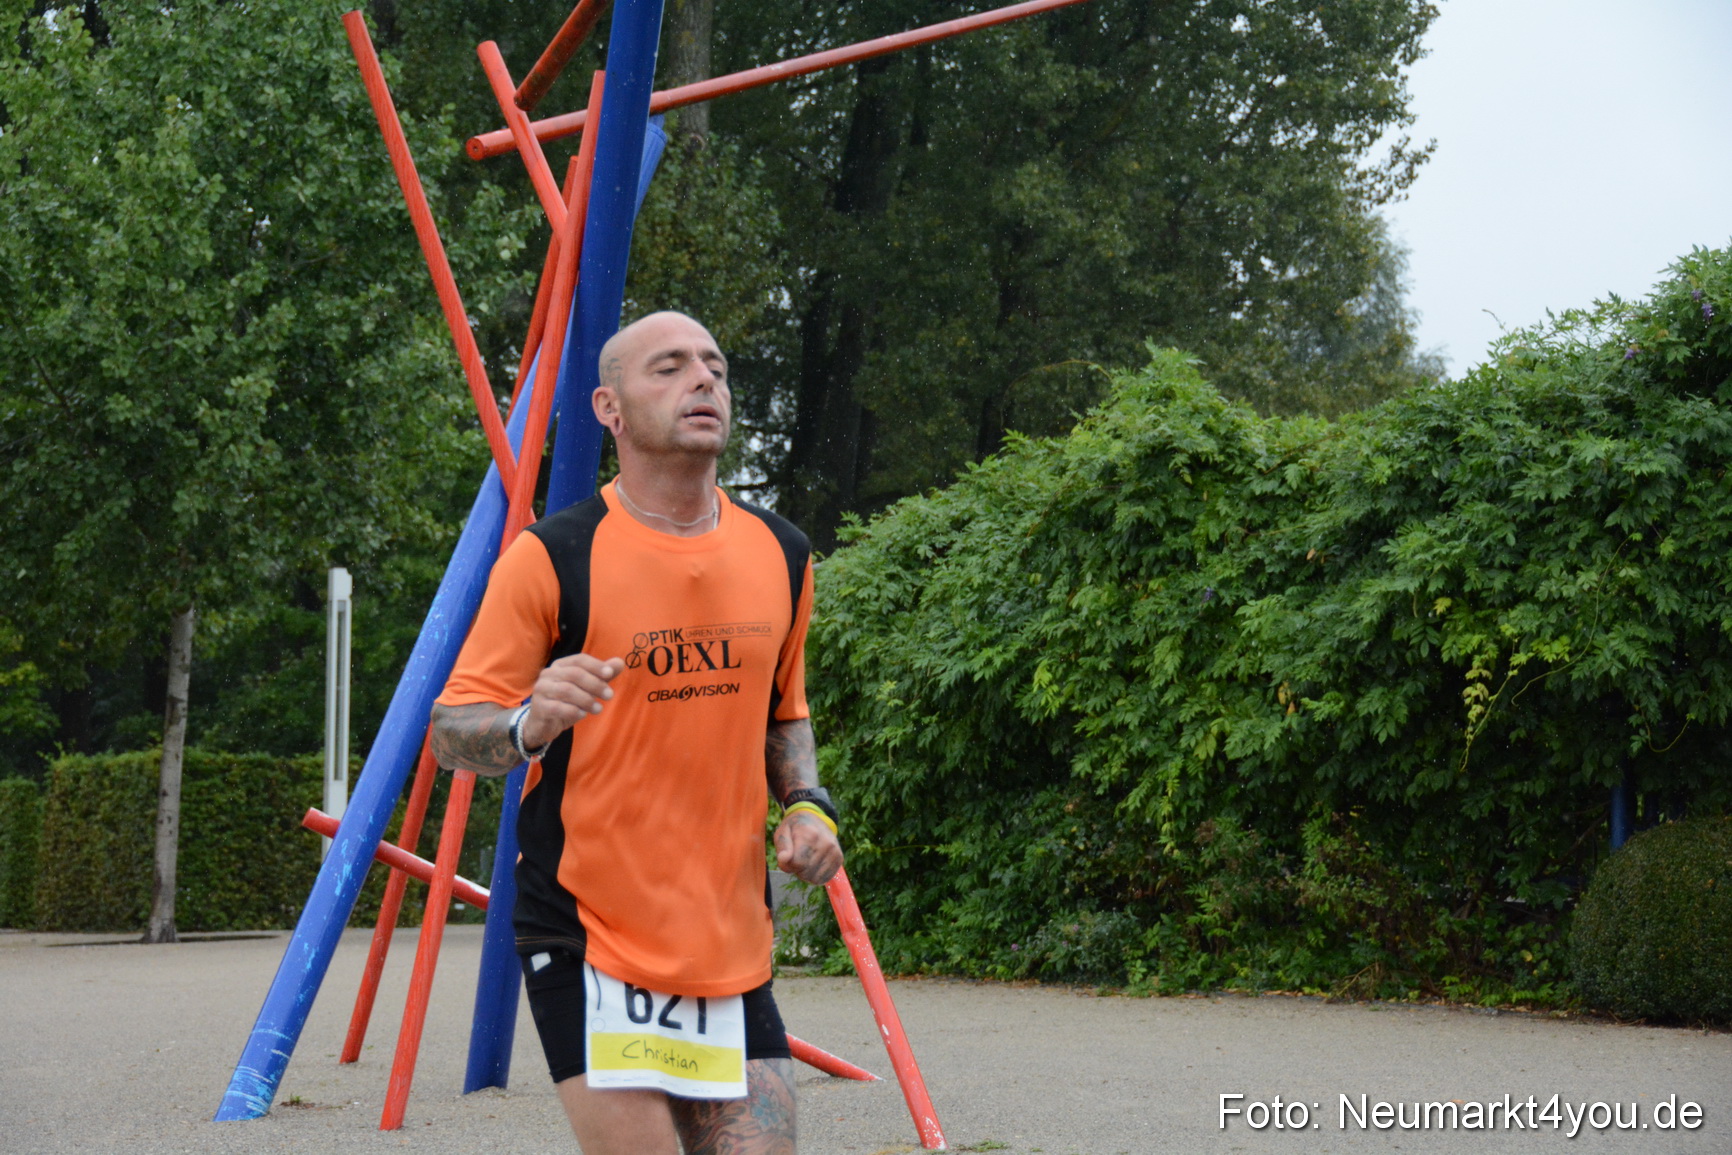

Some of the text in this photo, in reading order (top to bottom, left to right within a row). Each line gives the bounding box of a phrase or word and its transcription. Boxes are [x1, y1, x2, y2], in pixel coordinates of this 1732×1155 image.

[685, 625, 772, 639] UHREN UND SCHMUCK
[647, 639, 742, 677] OEXL
[621, 1040, 699, 1073] Christian
